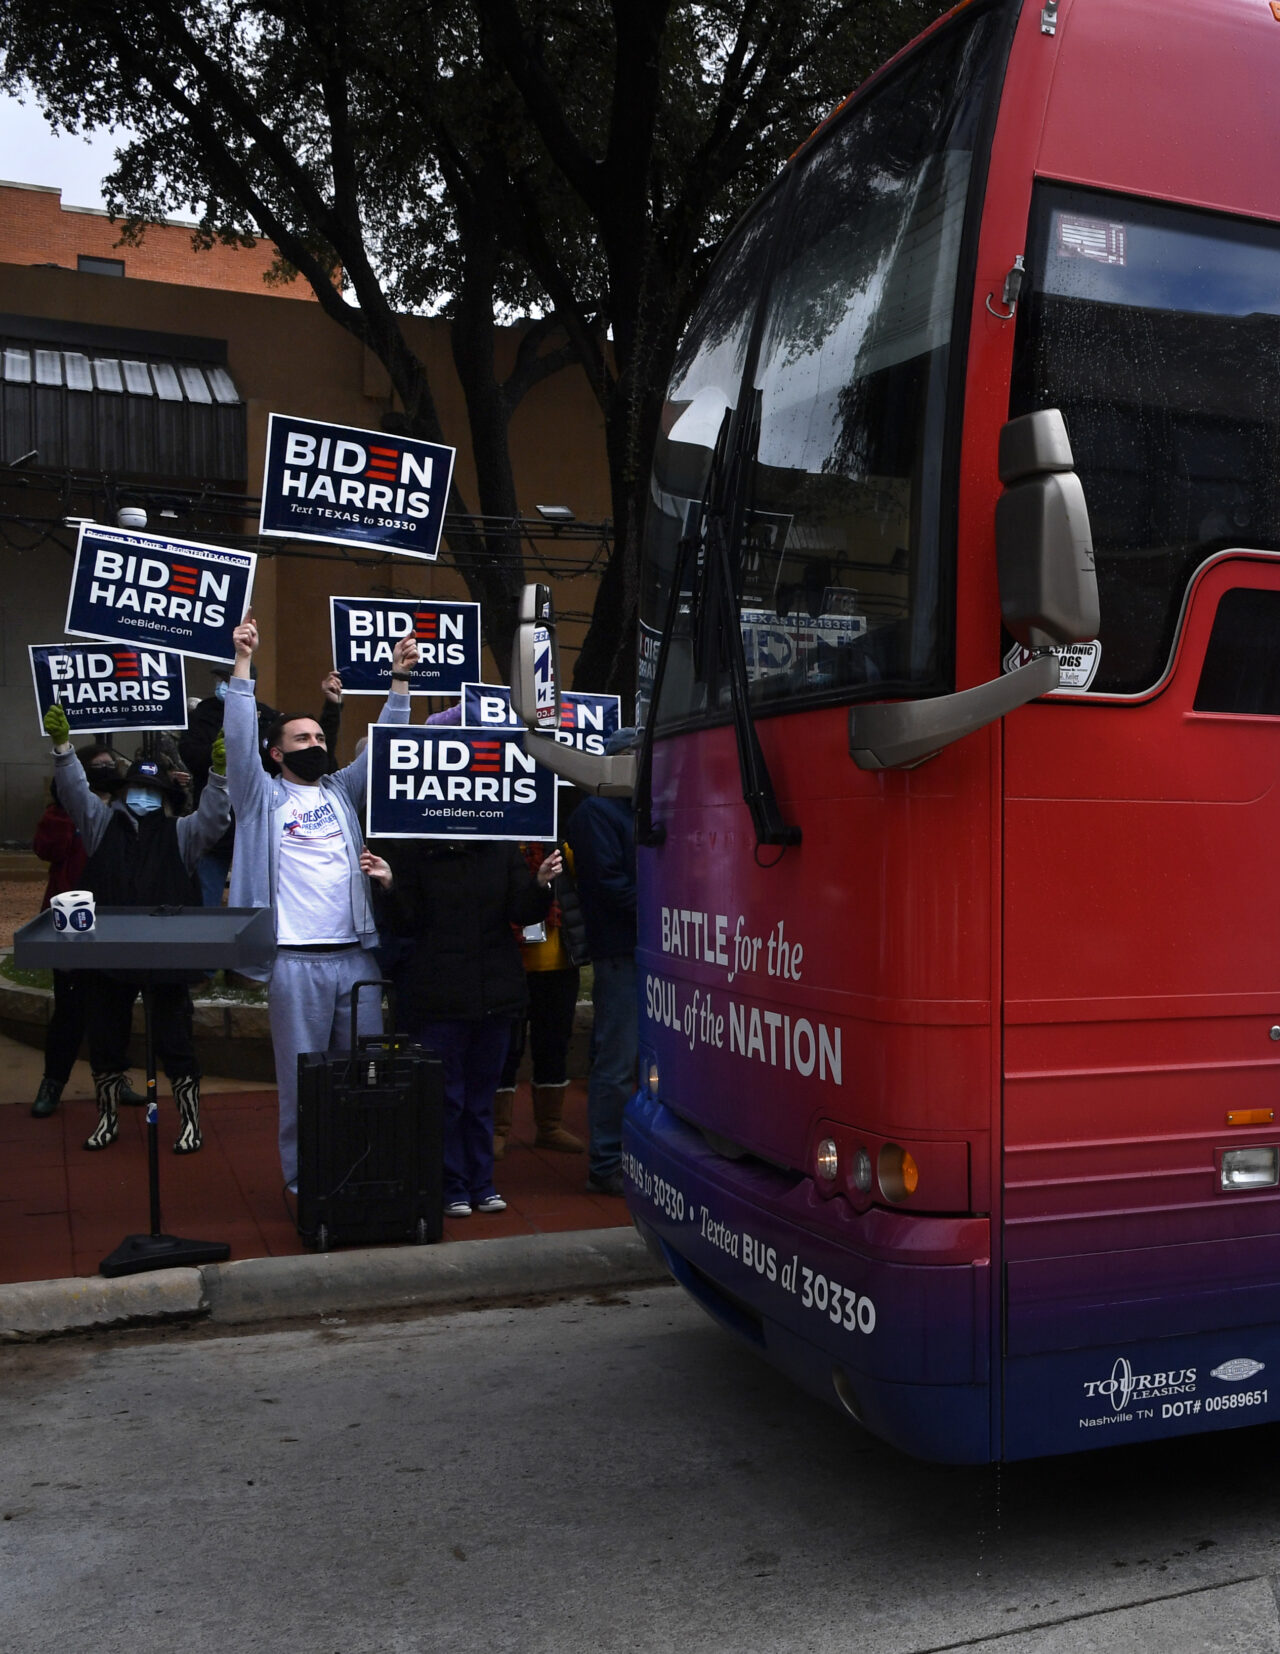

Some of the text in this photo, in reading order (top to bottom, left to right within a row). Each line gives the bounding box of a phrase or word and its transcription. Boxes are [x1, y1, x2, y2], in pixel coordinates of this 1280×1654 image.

[285, 431, 433, 489] BIDEN
[282, 469, 430, 519] HARRIS
[290, 503, 313, 515] Text
[316, 508, 360, 522] TEXAS
[363, 515, 374, 525] to
[377, 517, 417, 532] 30330
[93, 549, 231, 602] BIDEN
[89, 580, 226, 628] HARRIS
[117, 615, 193, 637] JoeBiden.com
[348, 609, 464, 640] BIDEN
[48, 652, 168, 680] BIDEN
[350, 640, 465, 666] HARIS
[1059, 655, 1082, 668] OGS
[377, 668, 440, 678] Joeen.com
[52, 680, 171, 704] HARRIS
[66, 704, 163, 716] Text TEXAS to 30330
[480, 695, 604, 731] BIEN
[389, 738, 536, 774] BIDEN
[388, 774, 537, 804] HARRIS
[421, 807, 504, 818] JoeBiden.com
[661, 906, 803, 983] BATTLE for the
[646, 973, 842, 1086] SOUL of the NATION
[629, 1153, 644, 1190] BUS
[644, 1168, 652, 1197] to
[653, 1174, 684, 1221] 30330
[700, 1205, 738, 1259] Textea
[743, 1233, 777, 1282] BUS
[782, 1255, 798, 1294] al
[801, 1266, 876, 1335] 30330
[1083, 1367, 1197, 1398] TOURBUS
[1132, 1384, 1197, 1400] LEASING
[1079, 1389, 1269, 1428] Nashville TN DOT# 00589651
